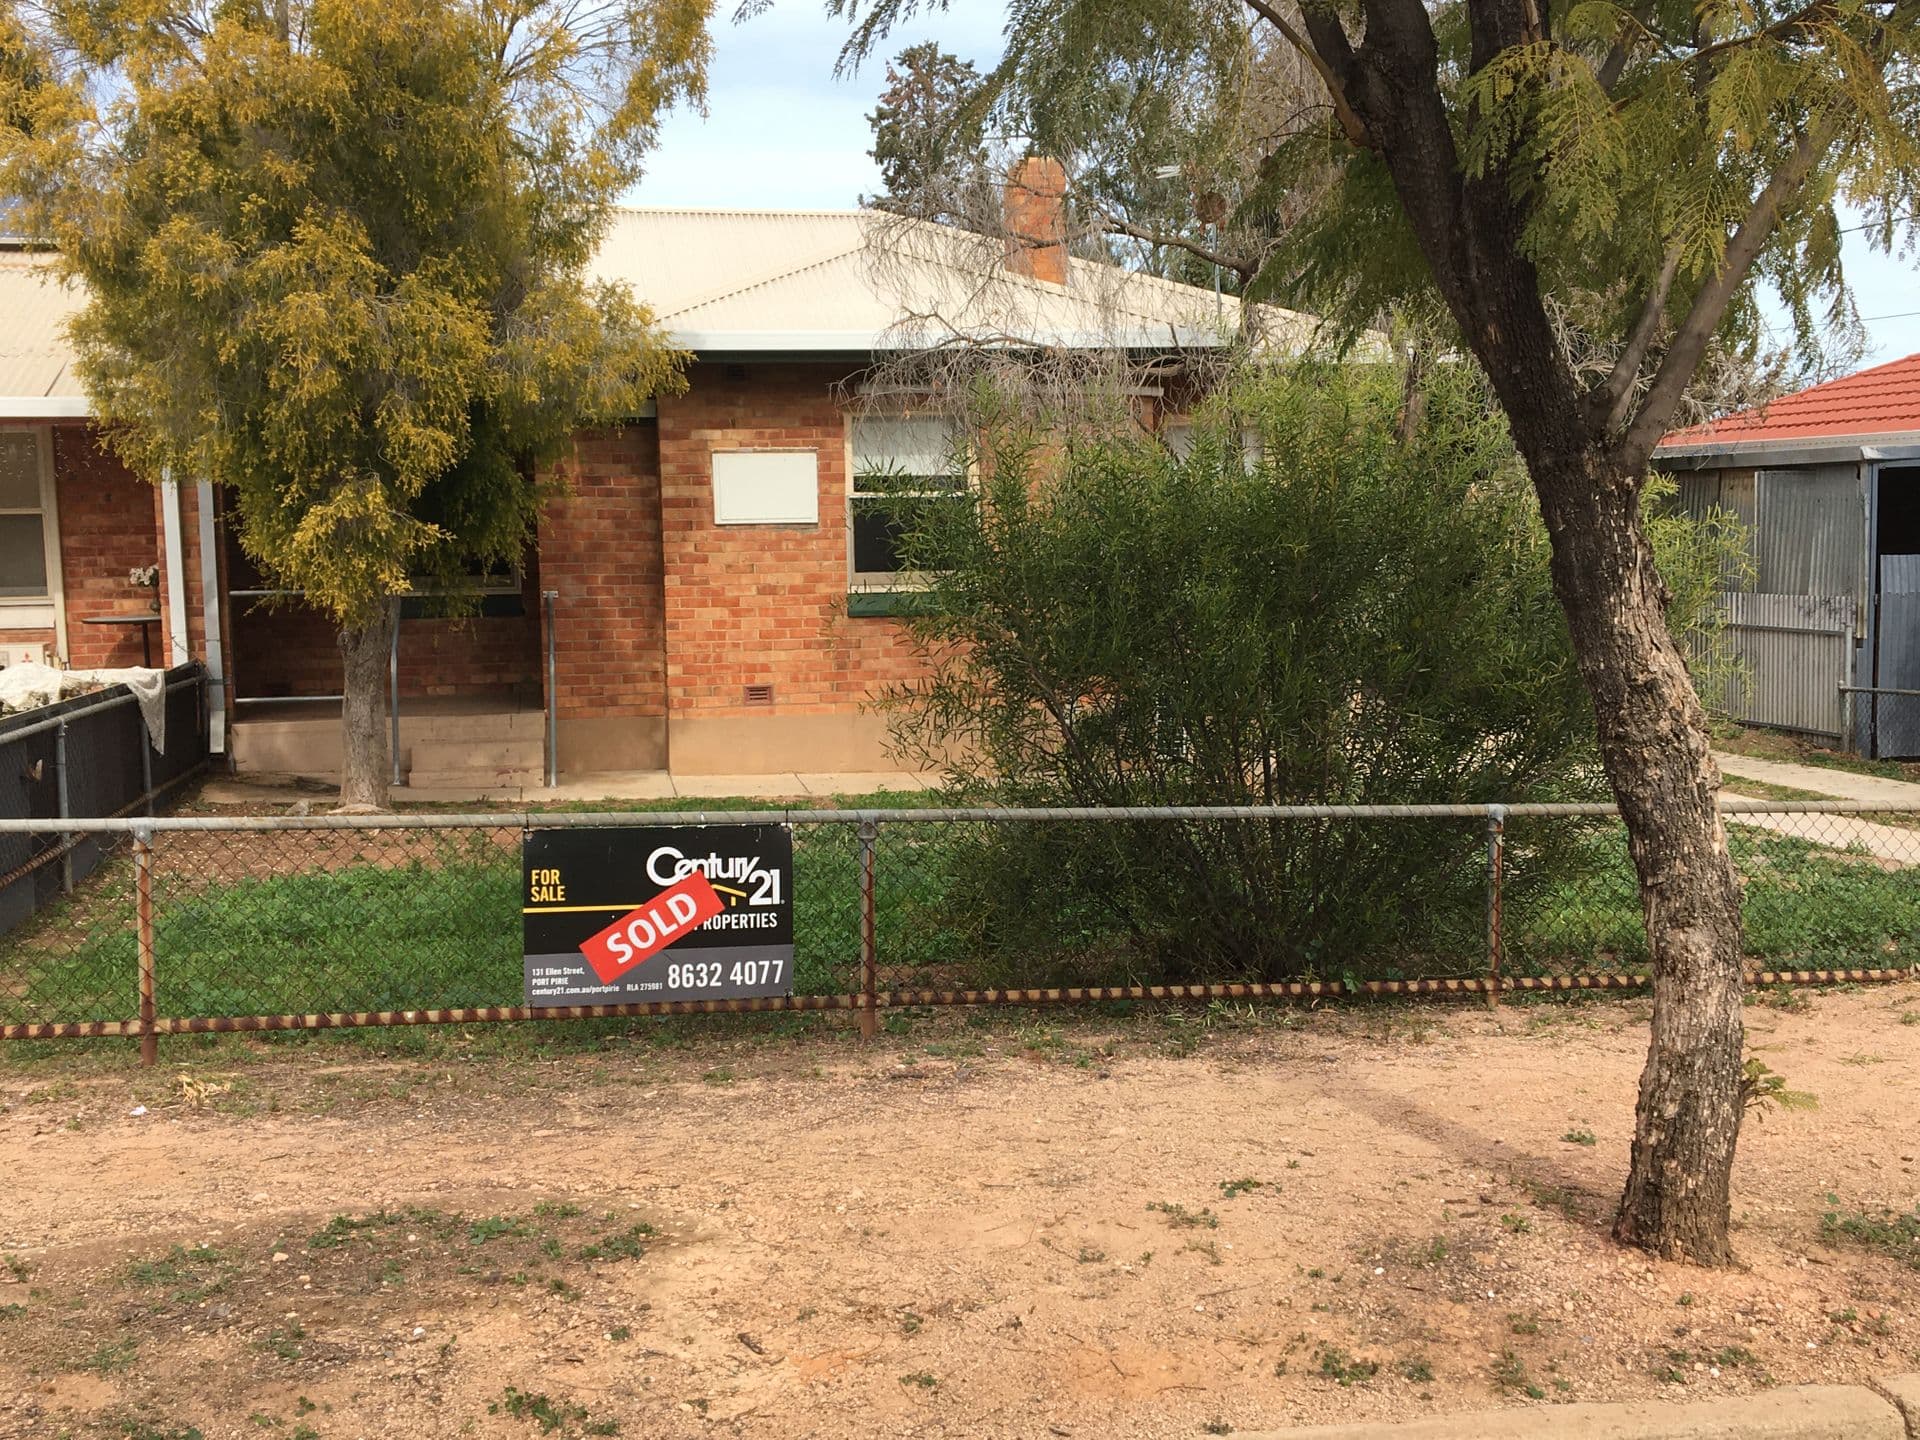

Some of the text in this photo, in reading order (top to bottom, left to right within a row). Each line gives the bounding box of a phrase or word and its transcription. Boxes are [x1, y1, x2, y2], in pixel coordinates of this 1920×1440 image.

[531, 869, 560, 886] FOR
[646, 846, 781, 906] Century 21
[531, 885, 566, 902] SALE
[606, 893, 698, 965] SOLD
[694, 912, 778, 931] ROPERTIES
[532, 966, 585, 976] 131 Ellen Street,
[667, 959, 784, 989] 8632 4077
[532, 977, 569, 986] PORT PIRIE
[626, 983, 639, 992] RLA
[531, 985, 620, 996] century21.com.au/portpirie
